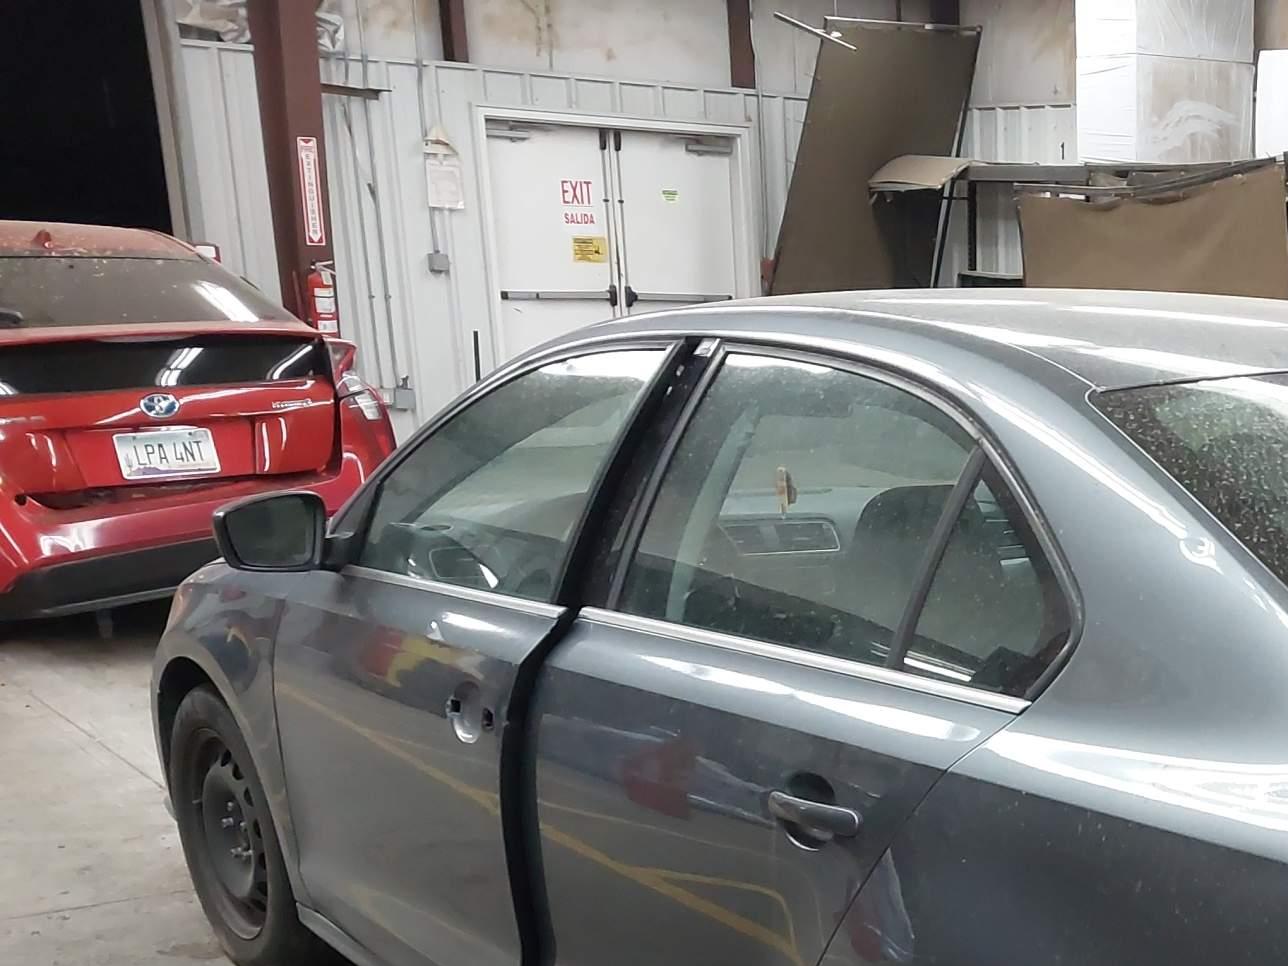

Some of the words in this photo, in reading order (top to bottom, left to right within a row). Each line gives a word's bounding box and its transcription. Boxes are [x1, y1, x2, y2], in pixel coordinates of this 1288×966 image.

[560, 180, 593, 206] EXIT
[563, 212, 596, 225] SALIDA
[133, 442, 170, 466] LPA
[172, 440, 204, 464] 4NT
